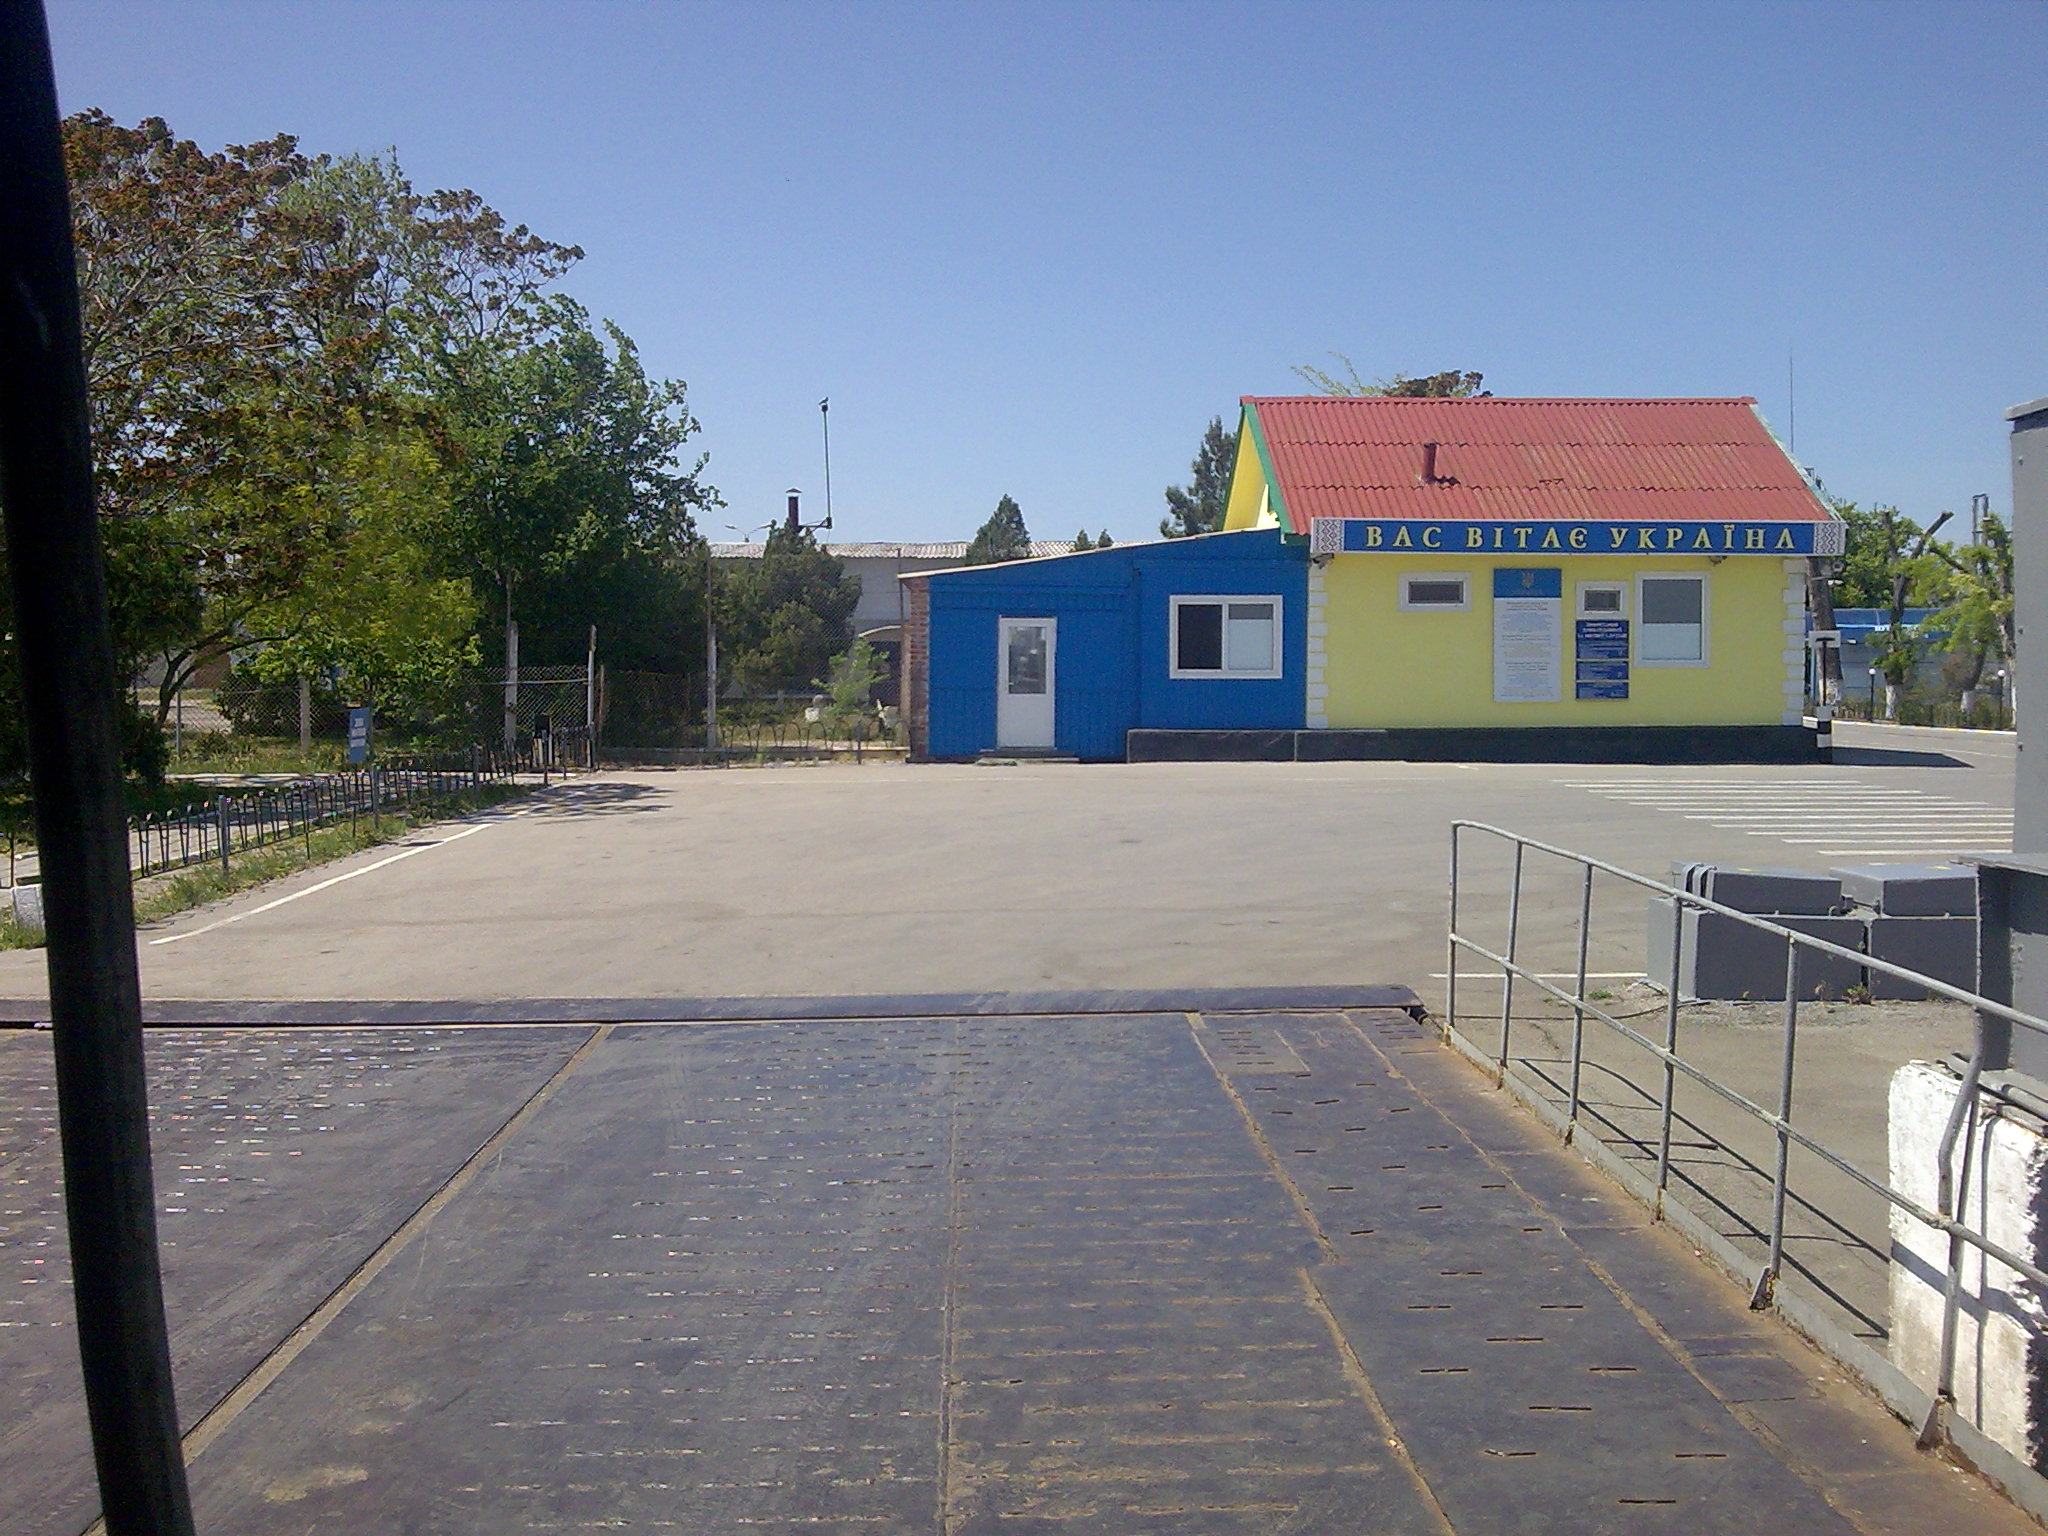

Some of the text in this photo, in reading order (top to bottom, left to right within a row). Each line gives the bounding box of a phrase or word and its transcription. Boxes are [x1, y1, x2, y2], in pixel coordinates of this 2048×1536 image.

[1366, 524, 1796, 549] ВАС ВІТАЄ УКРАЇНА
